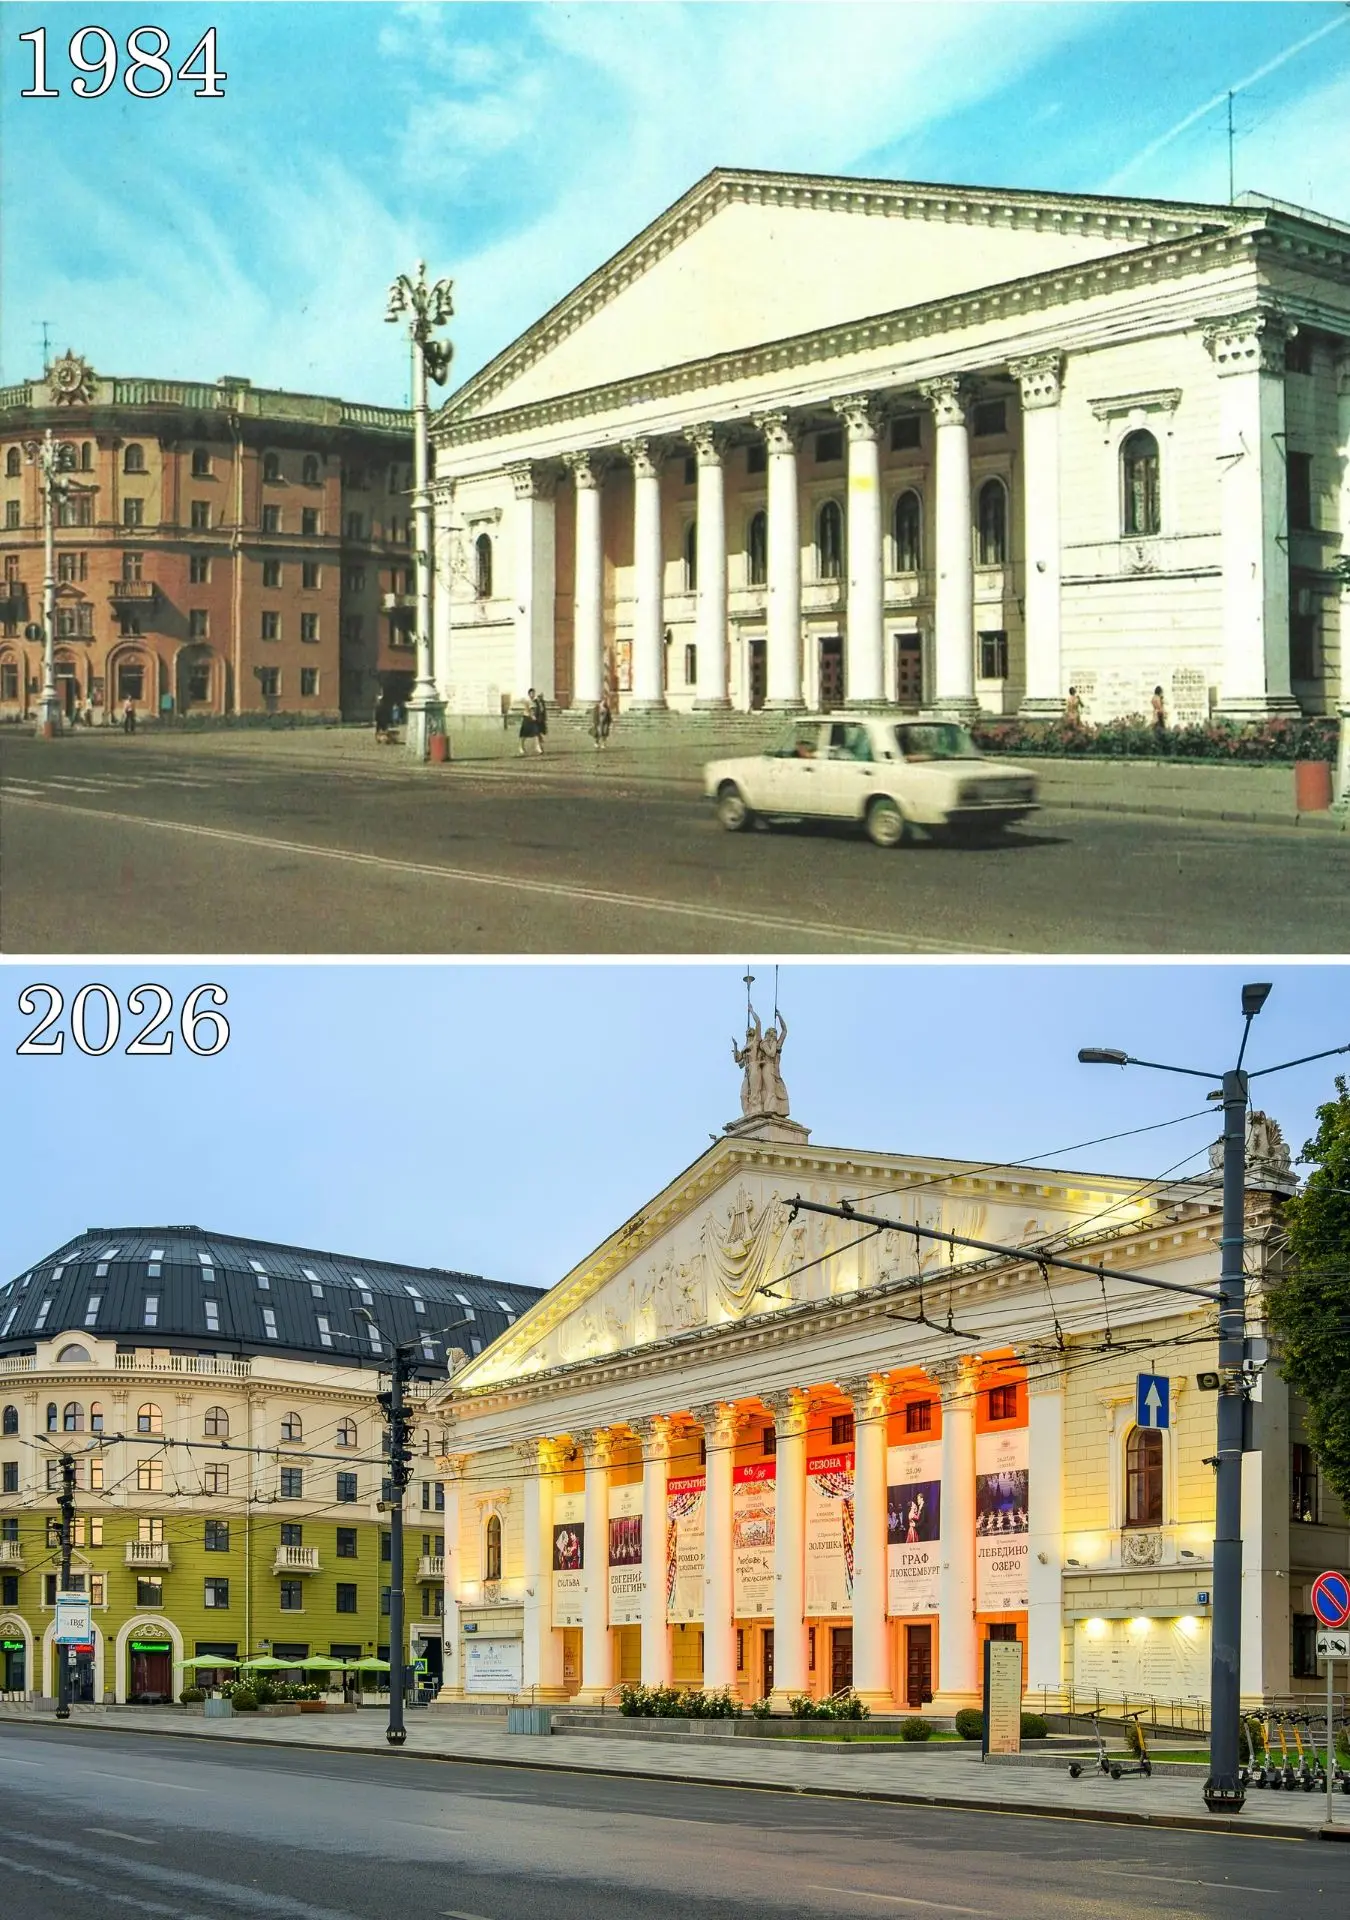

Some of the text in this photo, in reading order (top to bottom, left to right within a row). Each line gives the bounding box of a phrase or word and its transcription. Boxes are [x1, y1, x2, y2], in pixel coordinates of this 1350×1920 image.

[809, 1457, 842, 1471] СЕЗОНА
[808, 1540, 843, 1551] ЗОЛУШКА
[978, 1545, 1029, 1558] ЛЕБЕДИНО
[678, 1554, 700, 1563] РОМЕО
[902, 1553, 929, 1566] ГРАФ
[889, 1566, 941, 1578] ЛЮКСЕМБУРГ
[991, 1560, 1021, 1572] ОЗЕРО
[557, 1578, 580, 1588] СИЛЬВА
[612, 1583, 643, 1594] ОНЕГИН
